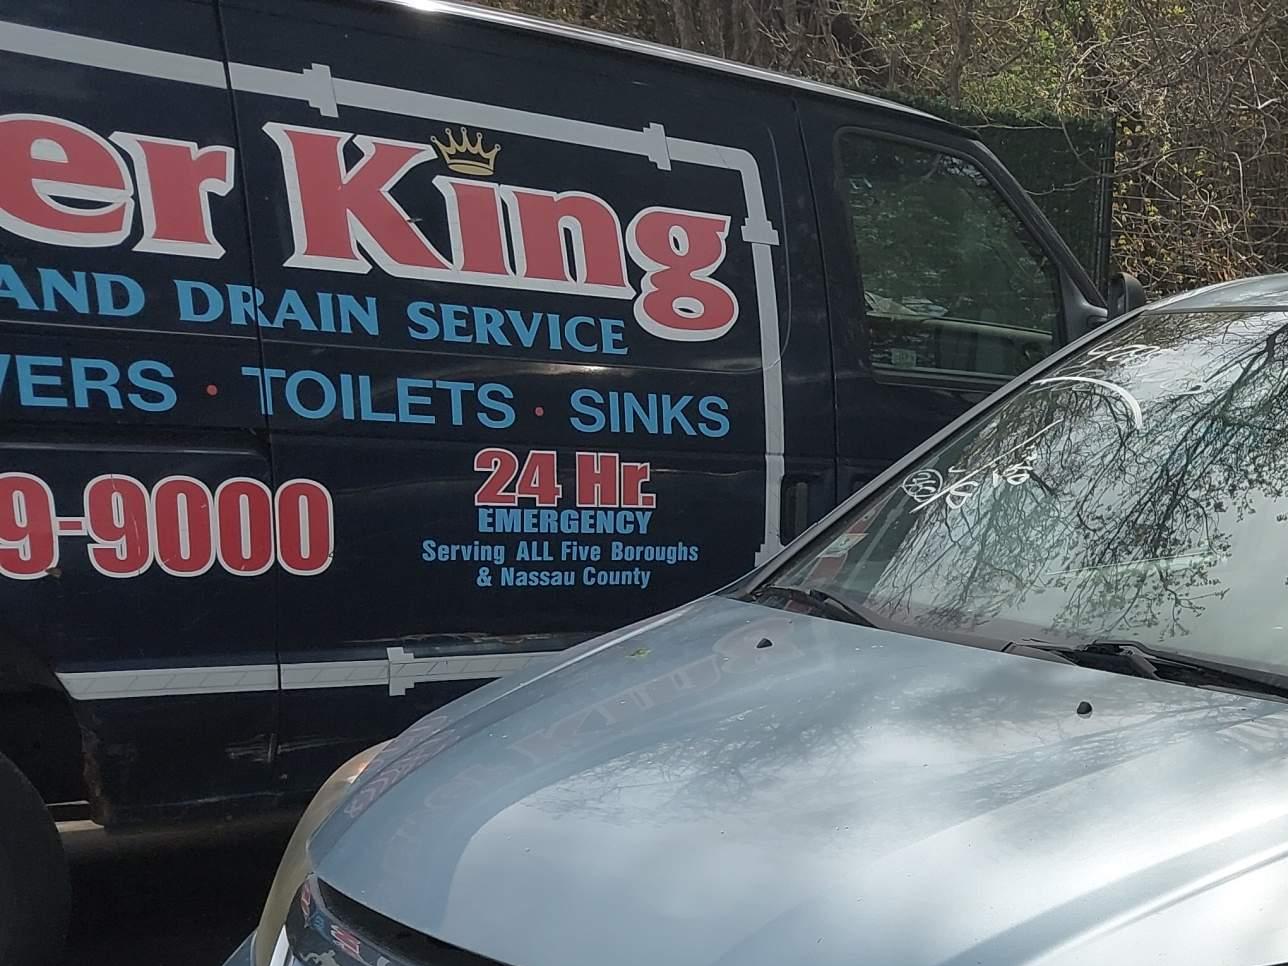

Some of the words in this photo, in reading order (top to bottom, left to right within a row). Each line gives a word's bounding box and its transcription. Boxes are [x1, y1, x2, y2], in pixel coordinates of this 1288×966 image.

[261, 121, 740, 342] King
[0, 263, 146, 318] AND
[173, 279, 380, 336] DRAIN
[406, 301, 629, 356] SERVICE
[0, 353, 178, 412] ERS
[241, 366, 517, 429] TOILETS
[569, 387, 731, 438] SINKS
[473, 447, 563, 507] 24
[575, 451, 657, 509] Hr.
[0, 471, 335, 580] 9-9000
[421, 539, 505, 565] Serving
[516, 541, 554, 562] ALL
[561, 541, 601, 562] Five
[611, 541, 699, 565] Boroughs
[477, 507, 653, 535] EMERGENCY
[476, 567, 493, 587] &
[501, 567, 576, 586] Nassau
[582, 566, 652, 589] County
